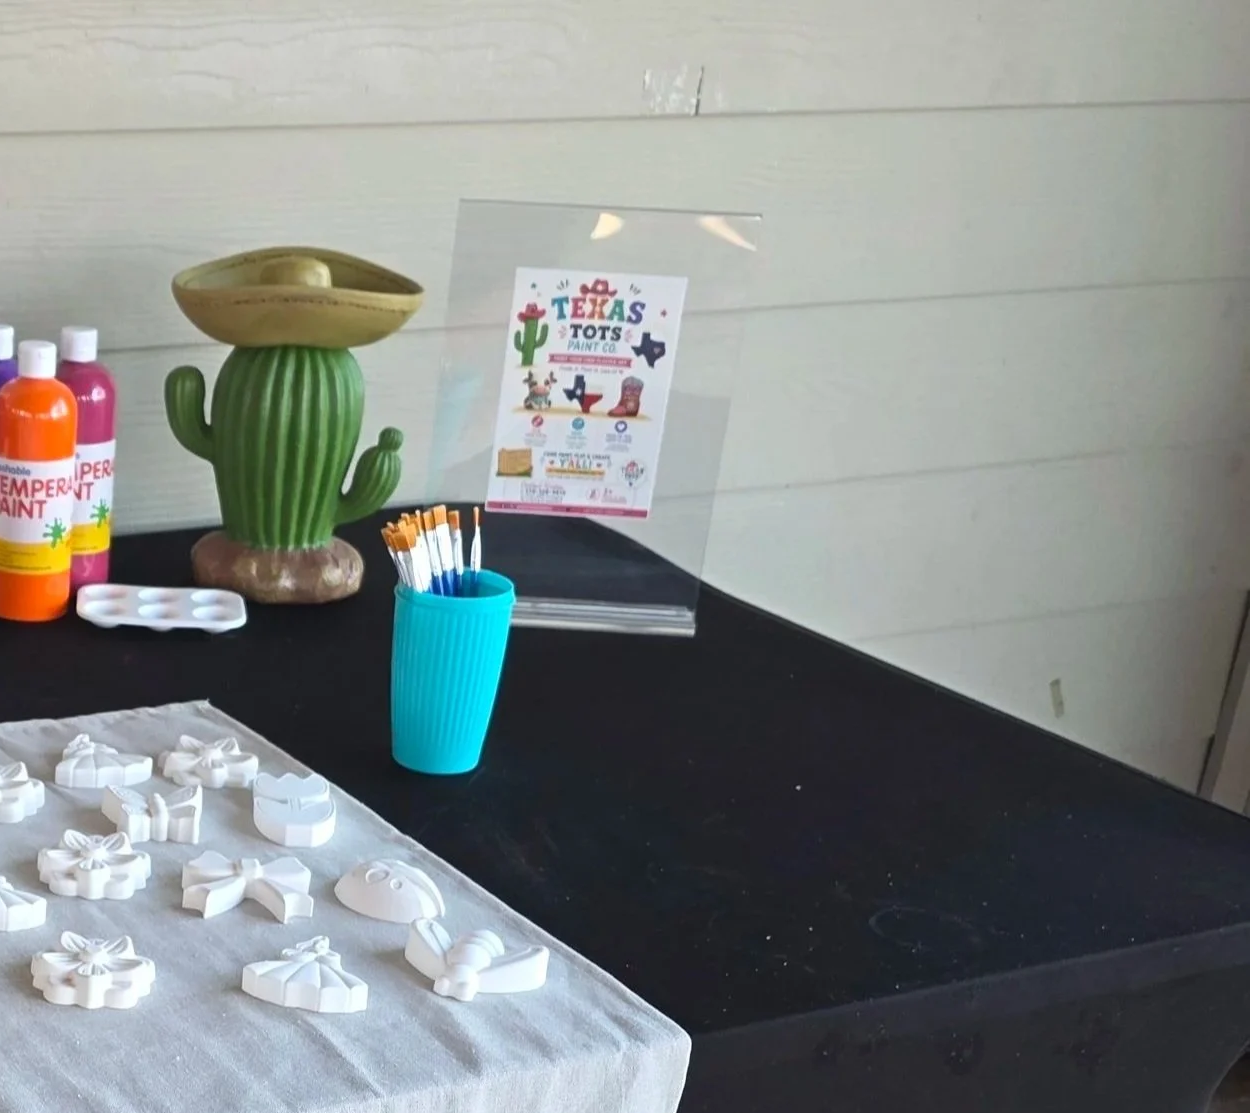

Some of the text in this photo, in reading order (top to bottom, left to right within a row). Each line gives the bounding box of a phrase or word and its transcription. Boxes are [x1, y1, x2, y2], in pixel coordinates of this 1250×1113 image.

[551, 296, 646, 325] TEXAS
[570, 324, 622, 341] TOTS
[567, 340, 597, 352] PAINT
